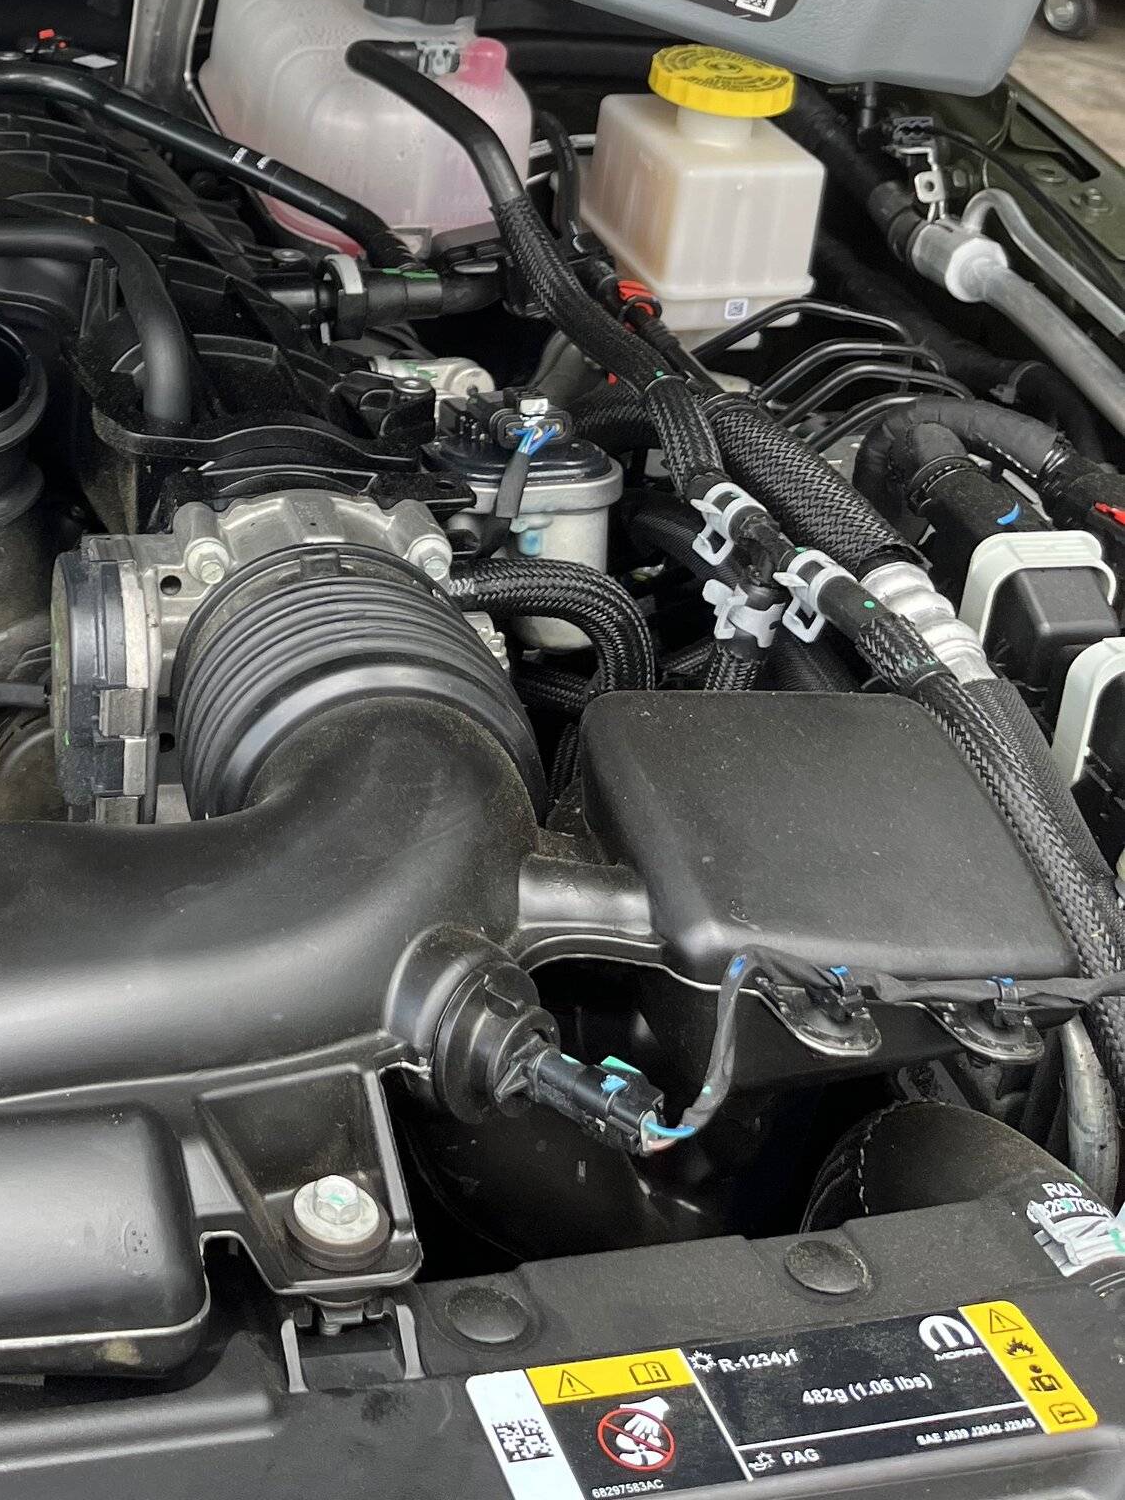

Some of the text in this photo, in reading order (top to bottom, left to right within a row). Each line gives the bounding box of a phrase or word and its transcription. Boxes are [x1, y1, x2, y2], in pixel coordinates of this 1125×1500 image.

[1041, 1182, 1083, 1198] RAD
[717, 1348, 799, 1373] R-1234yf
[802, 1372, 933, 1404] 482g (1.06 lbs)
[780, 1448, 821, 1467] PAG
[591, 1478, 665, 1499] 68297583AC
